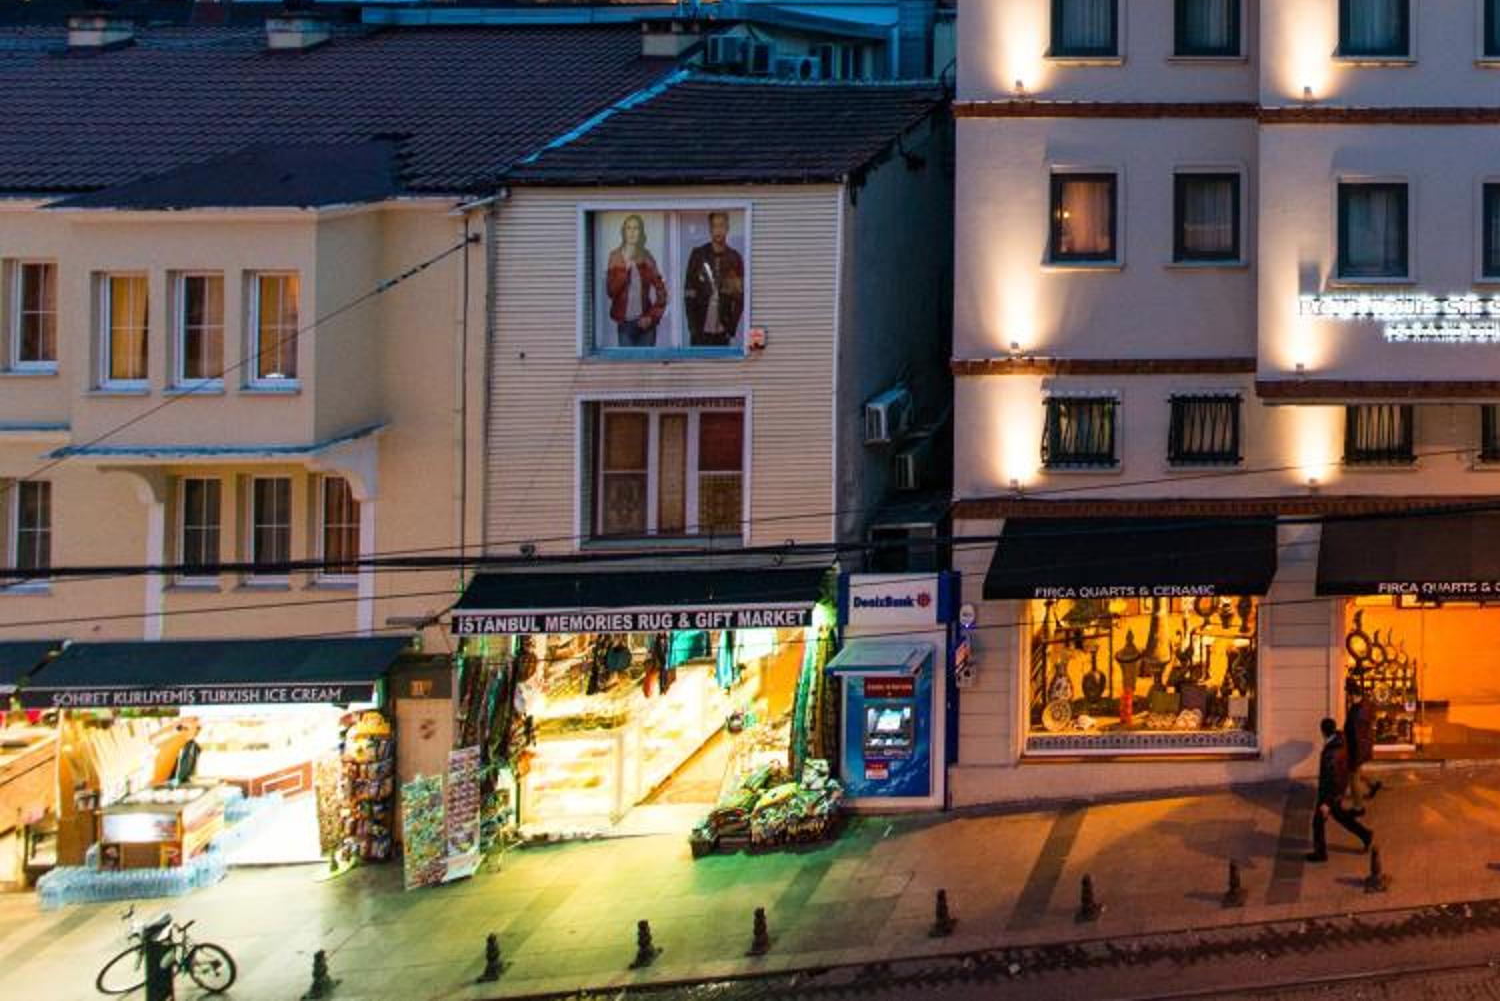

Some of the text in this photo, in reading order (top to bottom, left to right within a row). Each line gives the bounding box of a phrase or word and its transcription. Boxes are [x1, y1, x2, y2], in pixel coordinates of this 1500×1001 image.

[1079, 586, 1135, 598] QUARTS
[1139, 586, 1149, 596] &
[1153, 585, 1215, 596] CERAMIC
[1422, 582, 1477, 593] QUARTS
[1481, 582, 1491, 592] &
[545, 614, 633, 632] MEMORIES
[637, 613, 674, 629] RUG
[678, 613, 691, 628] &
[695, 612, 734, 628] GIFT
[737, 610, 807, 627] MARKET
[200, 688, 260, 702] TURKISH
[264, 687, 287, 701] ICE
[291, 687, 341, 701] CREAM
